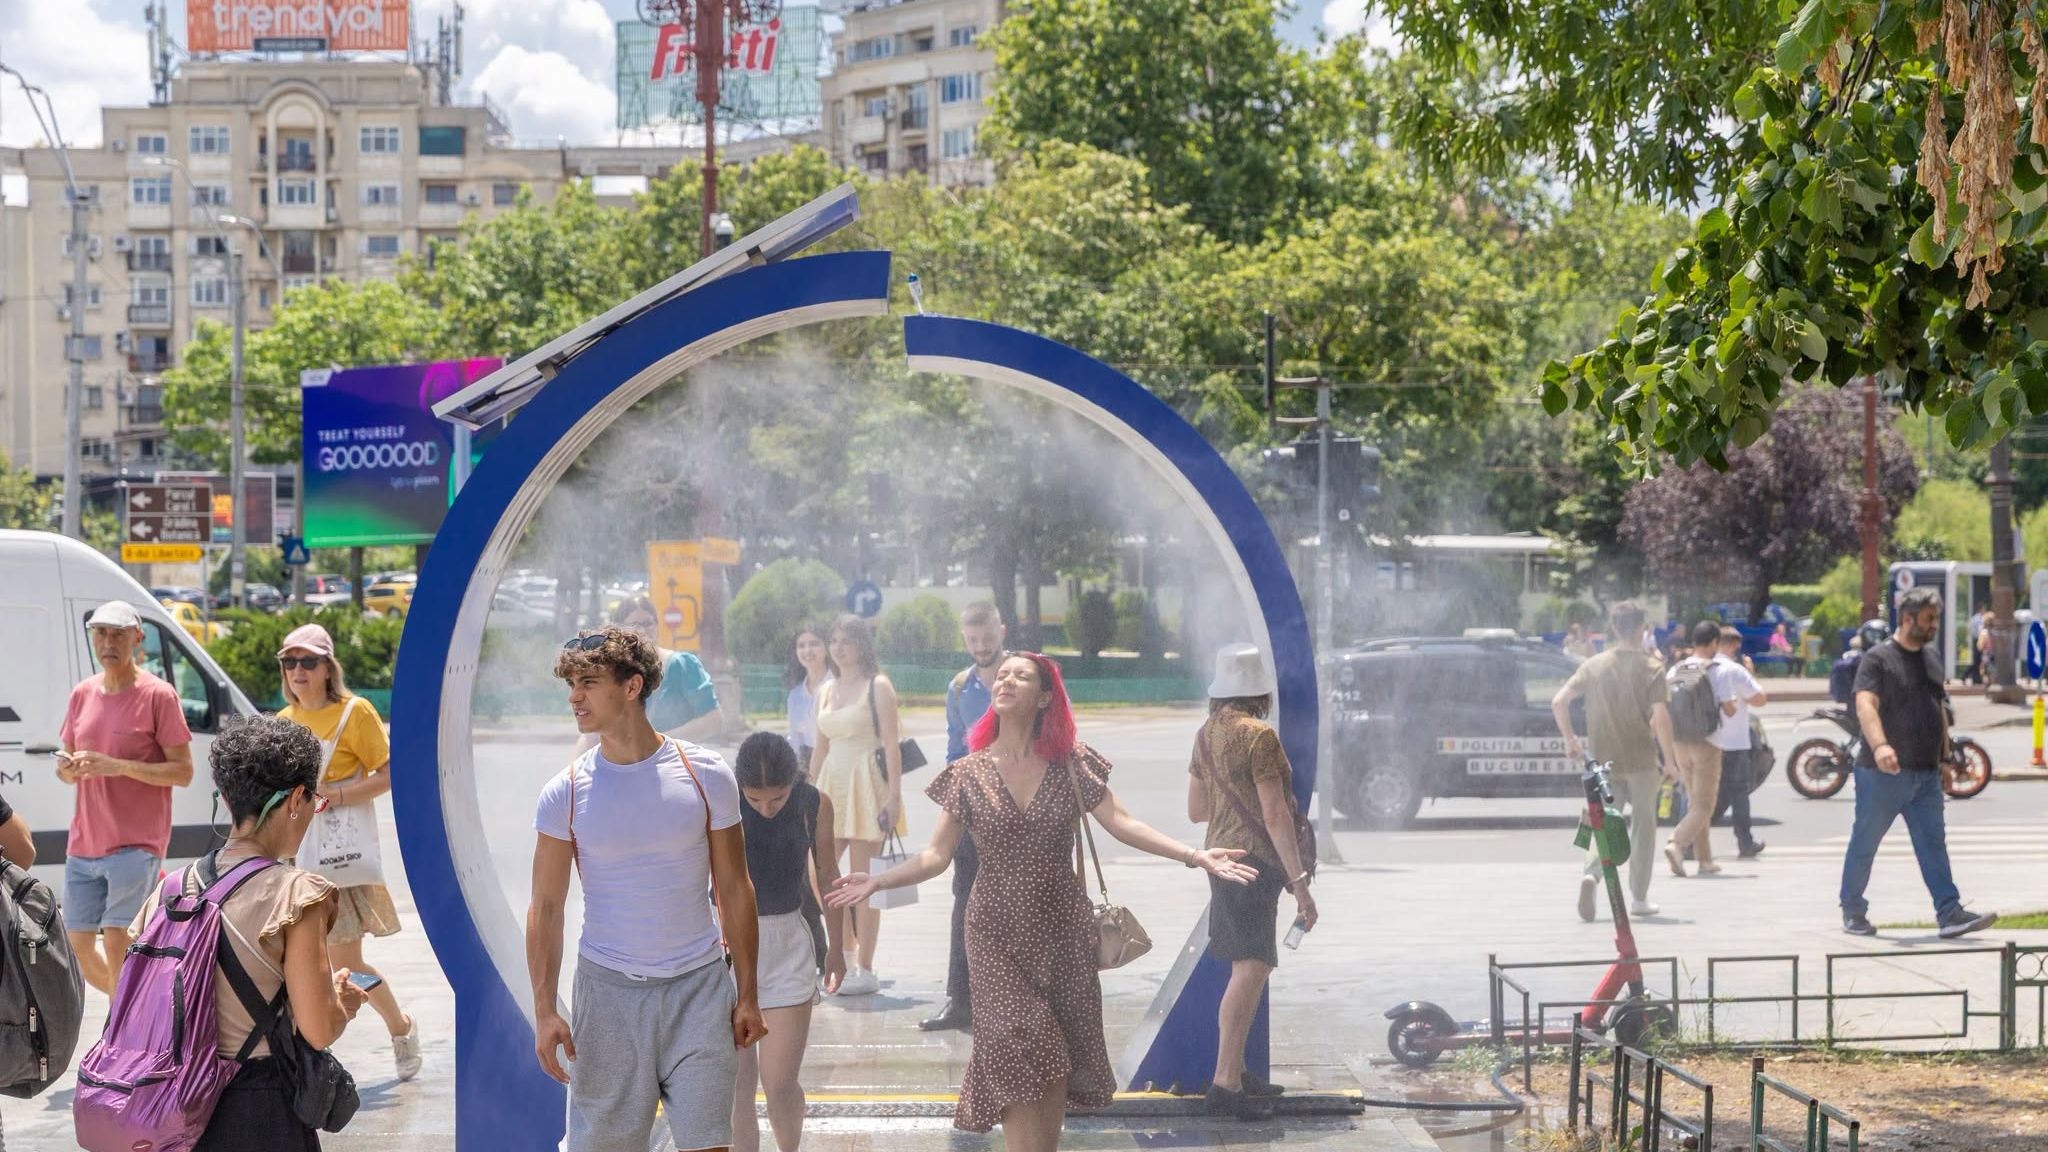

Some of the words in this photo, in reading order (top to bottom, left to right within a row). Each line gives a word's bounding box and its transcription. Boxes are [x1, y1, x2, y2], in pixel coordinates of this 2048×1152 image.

[213, 0, 382, 38] trendyol
[651, 17, 781, 80] Frtti
[318, 429, 349, 442] TREAT
[352, 425, 405, 440] YOURSELF
